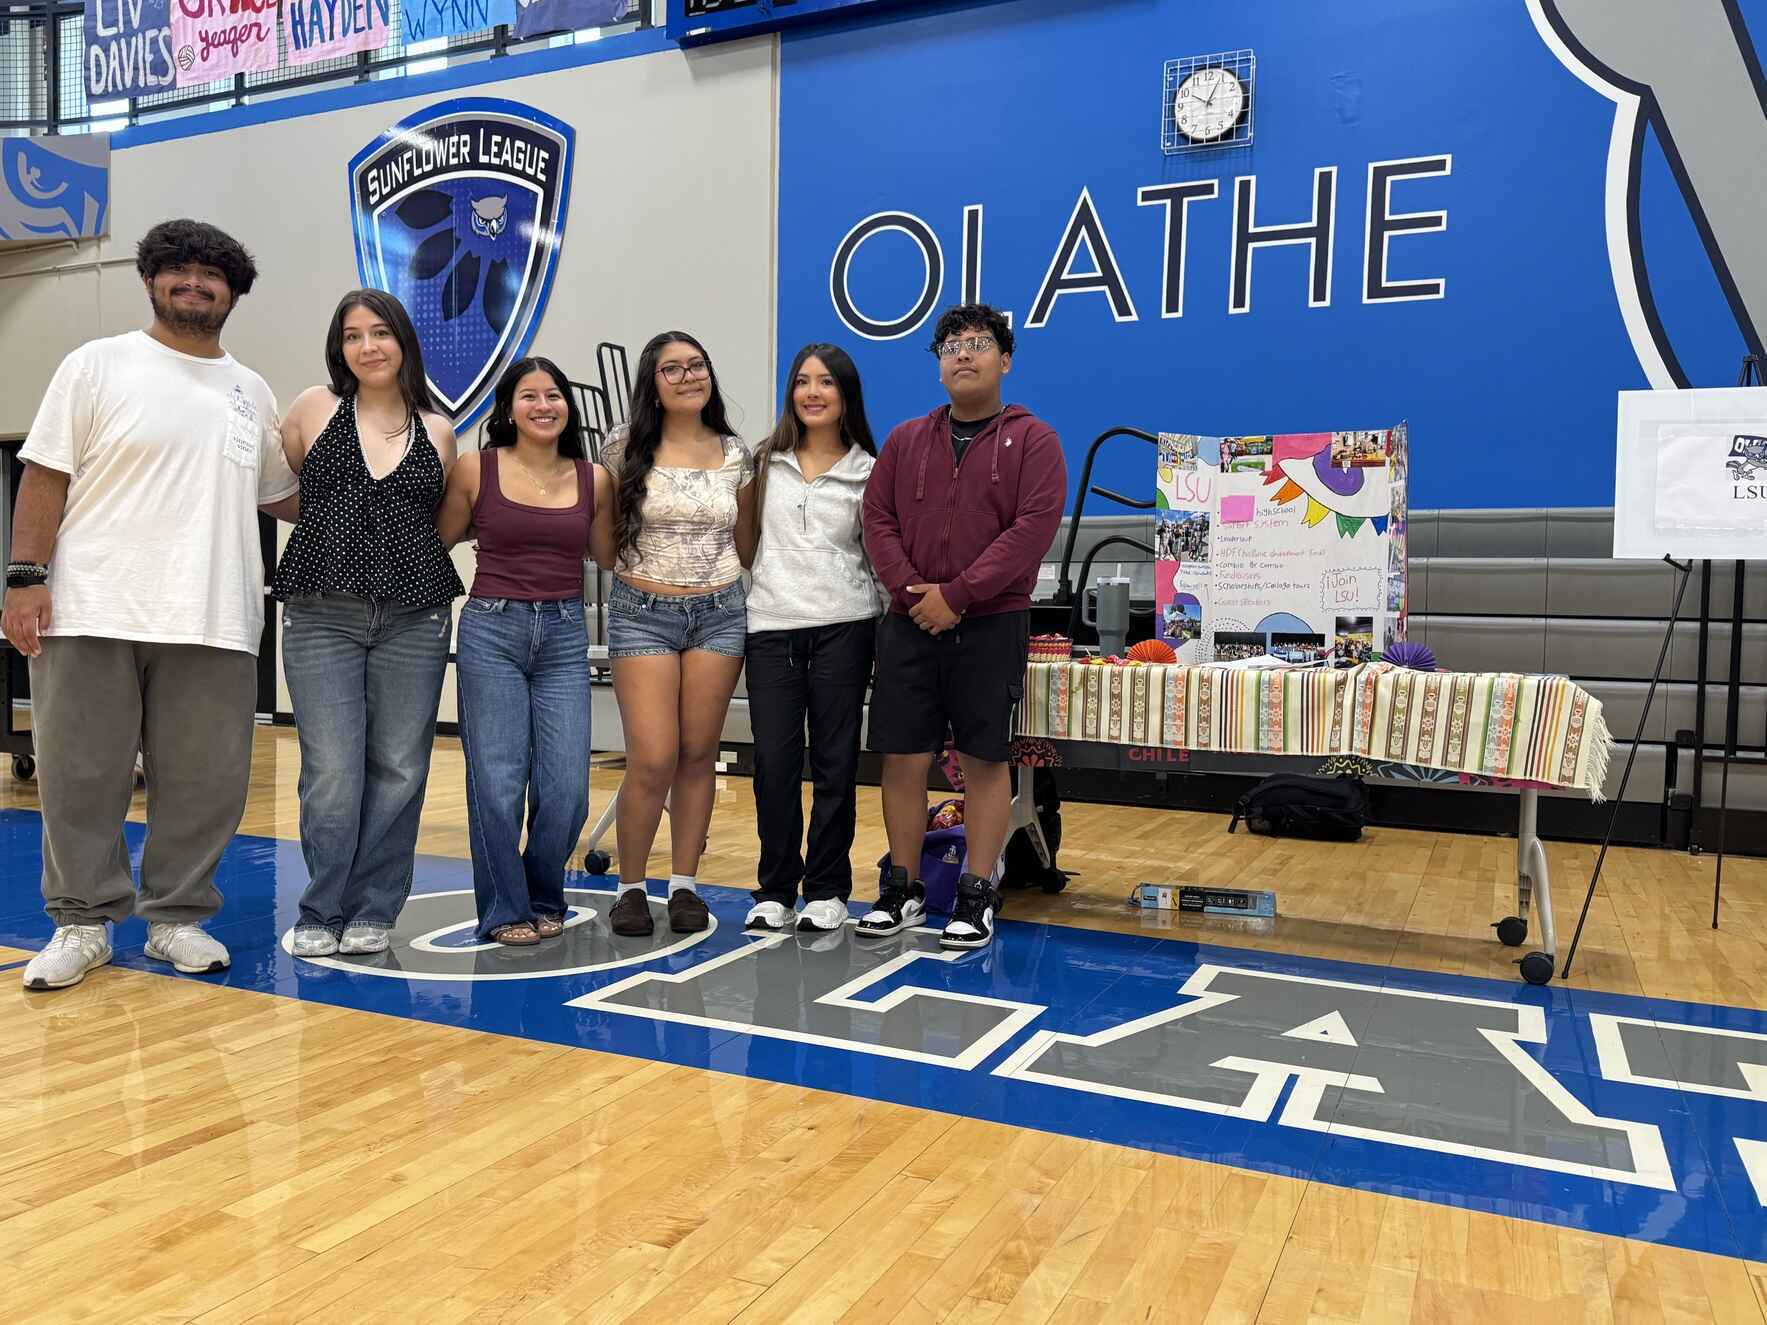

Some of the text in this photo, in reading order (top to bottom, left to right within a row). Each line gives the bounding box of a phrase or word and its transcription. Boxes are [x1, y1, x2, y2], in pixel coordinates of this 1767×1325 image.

[96, 0, 143, 37] LIV
[290, 0, 389, 50] HAYDEN
[90, 26, 176, 95] DAVIES
[1204, 71, 1214, 81] 12
[368, 128, 550, 205] SUNFLOWER LEAGUE
[1176, 471, 1212, 503] LSU
[1128, 748, 1191, 762] CHILE
